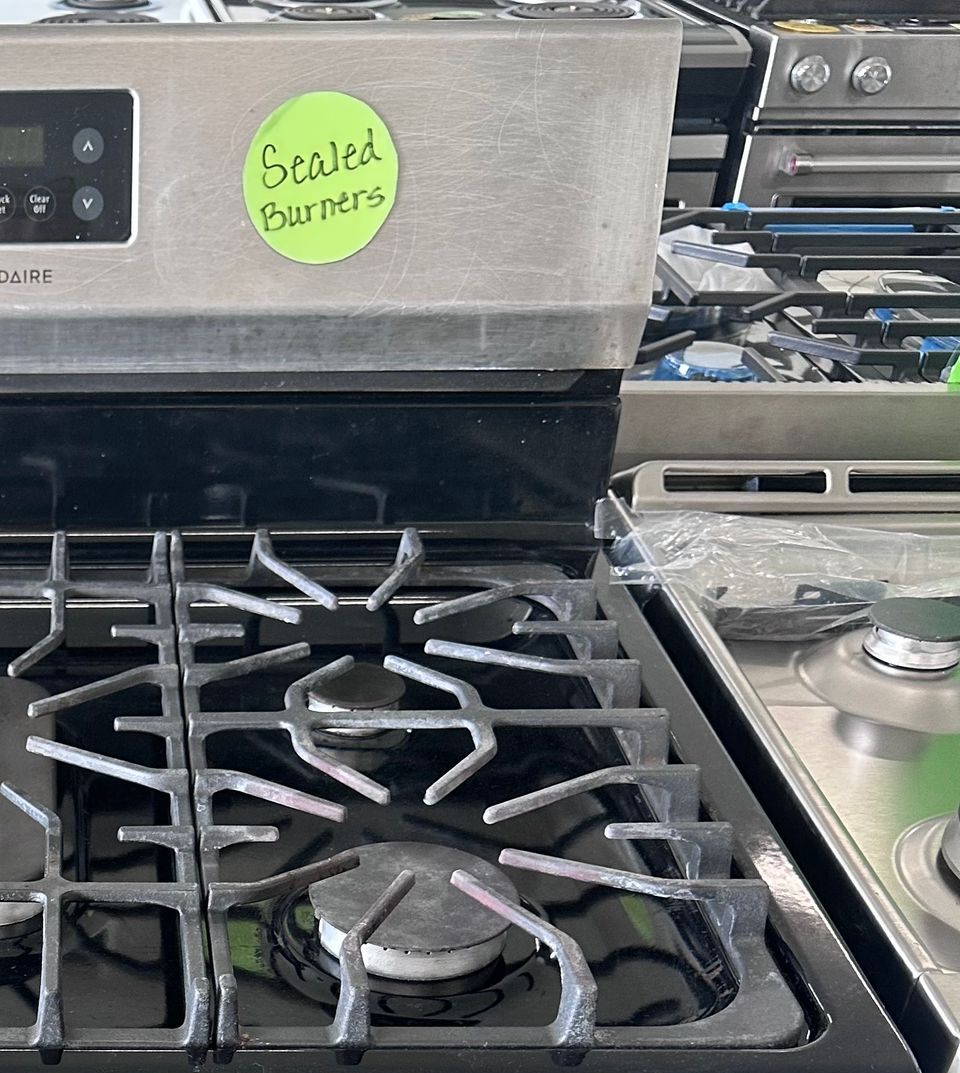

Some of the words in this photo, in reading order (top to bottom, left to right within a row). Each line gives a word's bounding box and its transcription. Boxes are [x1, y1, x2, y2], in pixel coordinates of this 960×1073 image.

[262, 128, 382, 189] Sealed
[29, 194, 51, 204] Clear
[259, 186, 386, 232] Burners
